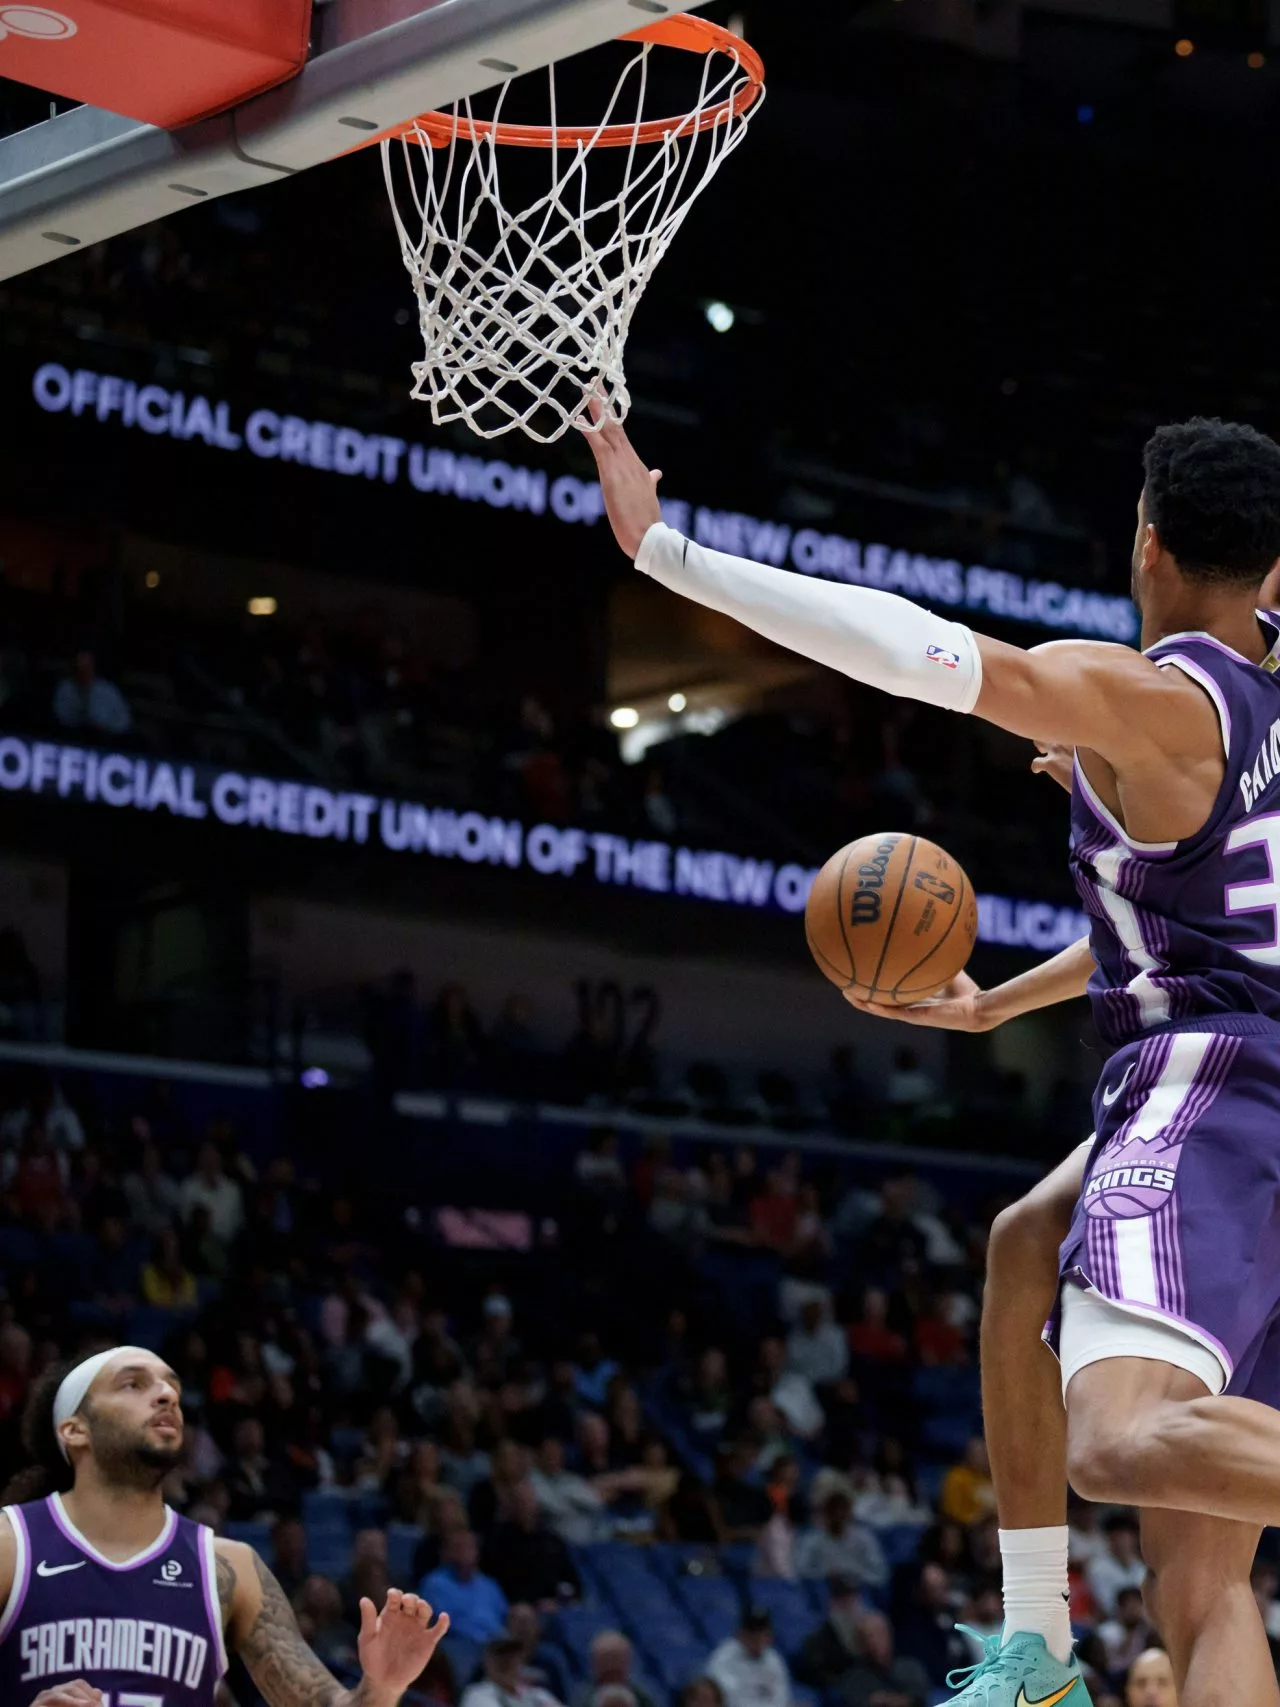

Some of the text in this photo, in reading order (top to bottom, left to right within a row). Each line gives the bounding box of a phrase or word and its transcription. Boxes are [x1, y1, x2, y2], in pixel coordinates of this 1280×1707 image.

[33, 363, 241, 449] OFFICIAL
[246, 409, 404, 481] CREDIT
[409, 446, 546, 514] UNION
[694, 506, 791, 567] NEW
[791, 528, 964, 603] ORLEANS
[966, 564, 1138, 641] PELICANS
[0, 737, 206, 818] OFFICIAL
[211, 772, 377, 843] CREDIT
[380, 800, 522, 867] UNION
[526, 823, 587, 876] OF
[588, 832, 670, 892] THE
[674, 847, 774, 906] NEW
[1086, 1168, 1175, 1197] KINGS
[20, 1618, 208, 1689] SACRAMENTO
